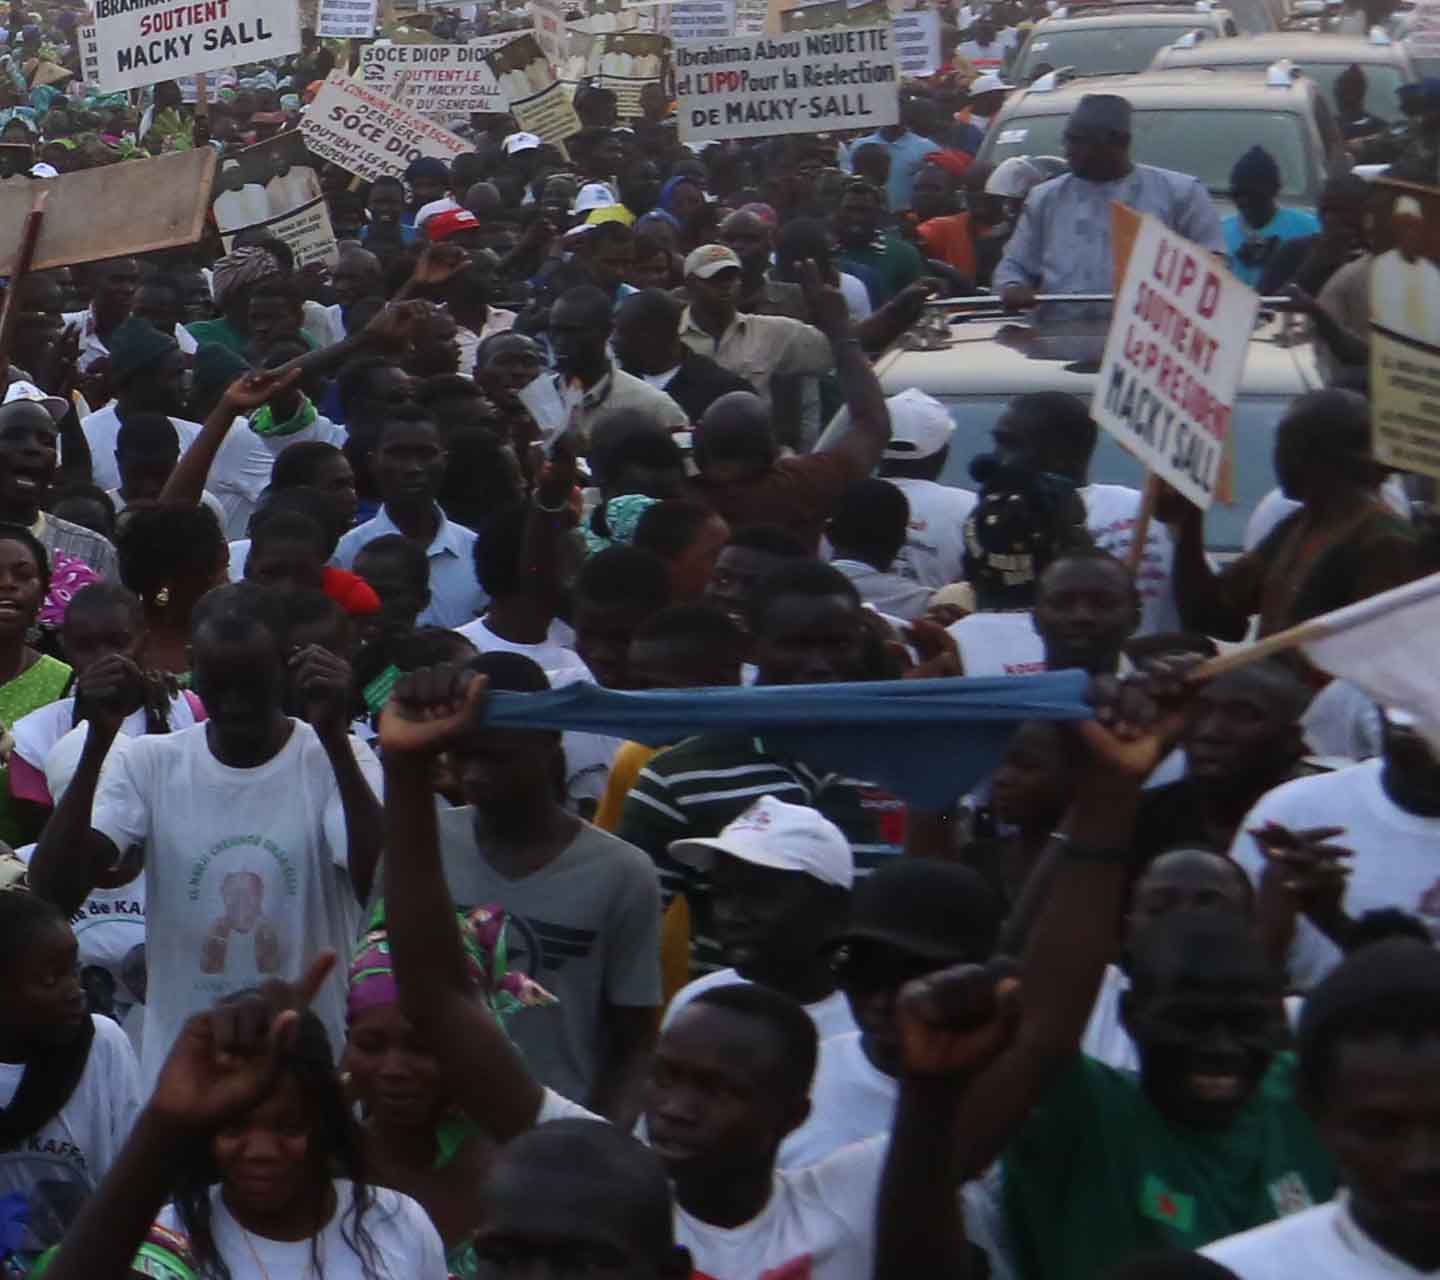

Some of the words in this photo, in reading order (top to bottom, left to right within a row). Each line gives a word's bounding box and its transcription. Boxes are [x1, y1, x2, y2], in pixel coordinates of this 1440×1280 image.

[117, 33, 193, 72] MACKY
[203, 18, 272, 51] SALL
[363, 48, 408, 63] SOCE
[412, 48, 450, 62] DIOP
[677, 43, 751, 67] Ibrahima
[754, 38, 801, 61] Abou
[805, 29, 888, 56] NGUETTE
[465, 70, 480, 82] LE
[783, 66, 797, 90] la
[470, 84, 500, 96] SALL
[437, 98, 491, 110] SENEGAL
[355, 104, 425, 145] DERRIERE
[691, 109, 721, 128] DE
[302, 119, 361, 153] SOUTIENT
[328, 106, 385, 143] SOCE
[385, 137, 422, 163] DIO
[1104, 362, 1175, 454] MACKY
[1170, 422, 1216, 494] SALL
[89, 900, 110, 915] de
